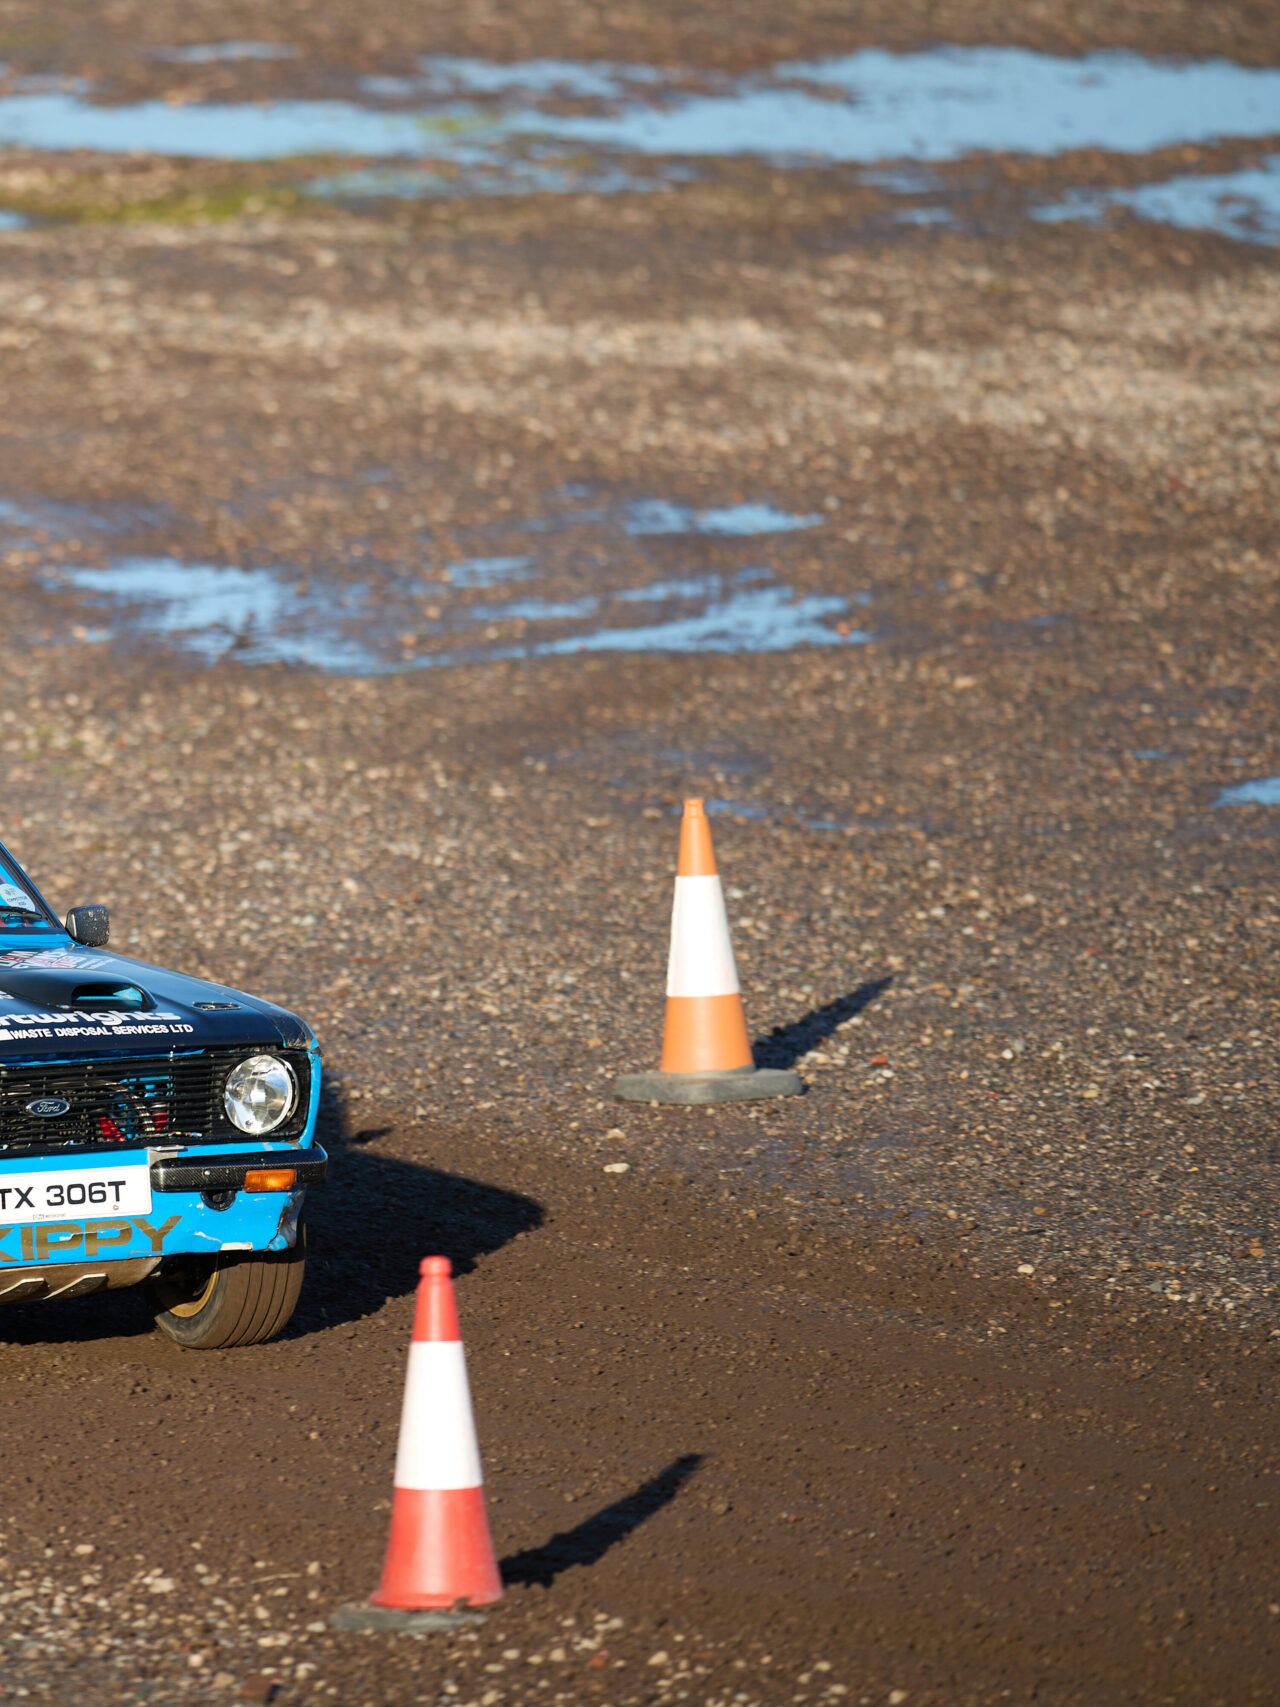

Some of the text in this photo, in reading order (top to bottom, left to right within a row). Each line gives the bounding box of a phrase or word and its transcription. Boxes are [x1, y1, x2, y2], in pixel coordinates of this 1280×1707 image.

[11, 1023, 194, 1040] WASTE DISPOSAL SERVICES LTD
[36, 1101, 61, 1113] Ford
[46, 1181, 127, 1206] 306T
